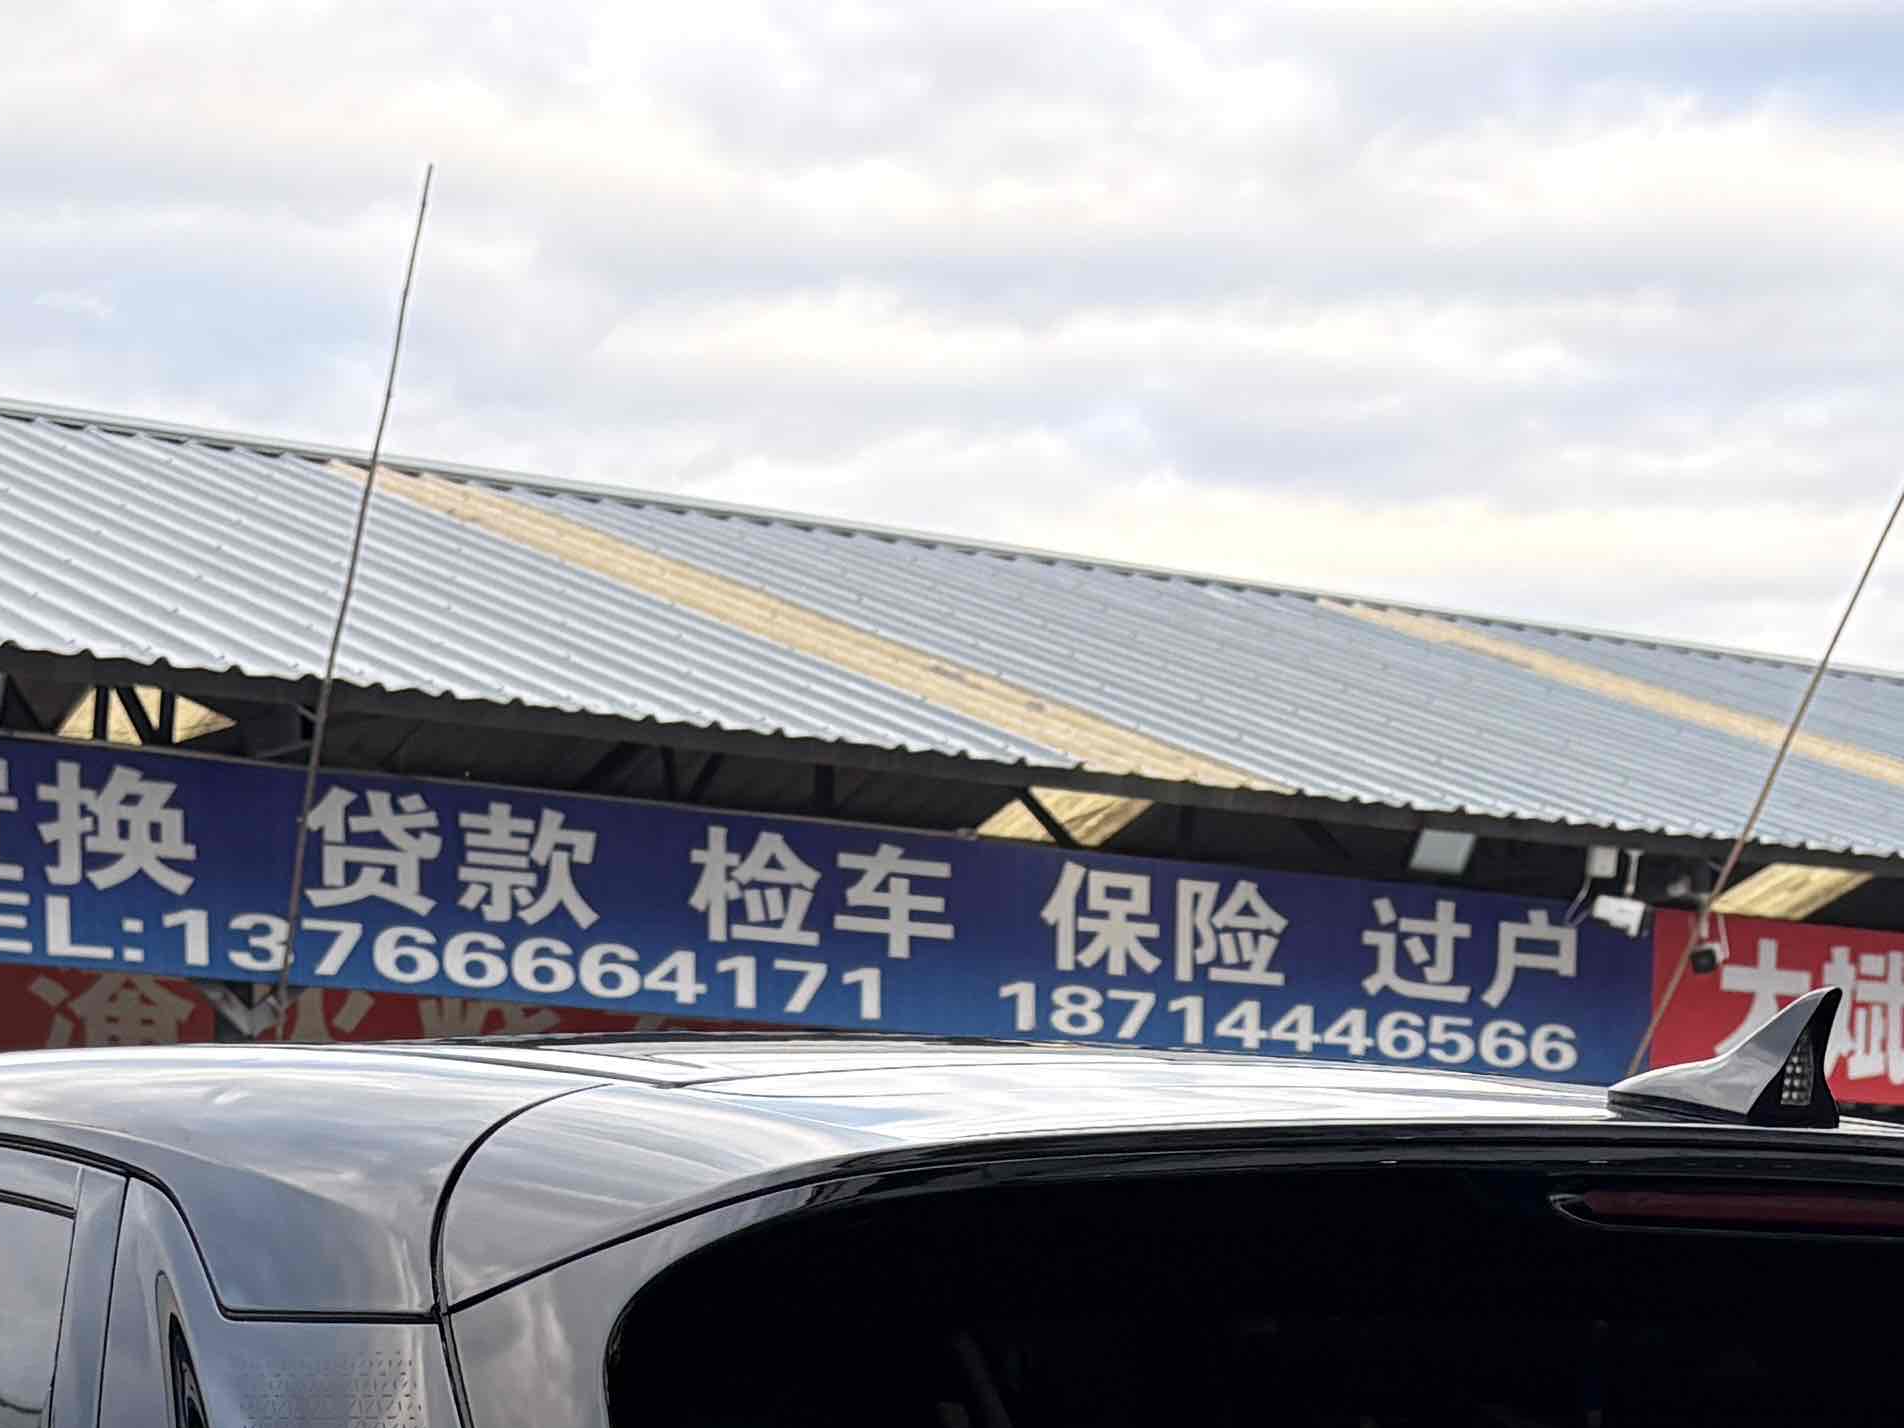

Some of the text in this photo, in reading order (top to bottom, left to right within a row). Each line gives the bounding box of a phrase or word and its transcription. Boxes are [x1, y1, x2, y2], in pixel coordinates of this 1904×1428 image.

[306, 783, 600, 930] 贷款
[690, 825, 955, 960] 检车
[1040, 860, 1288, 989] 保险
[1361, 896, 1579, 1009] 过户
[998, 980, 1579, 1073] 18714446566
